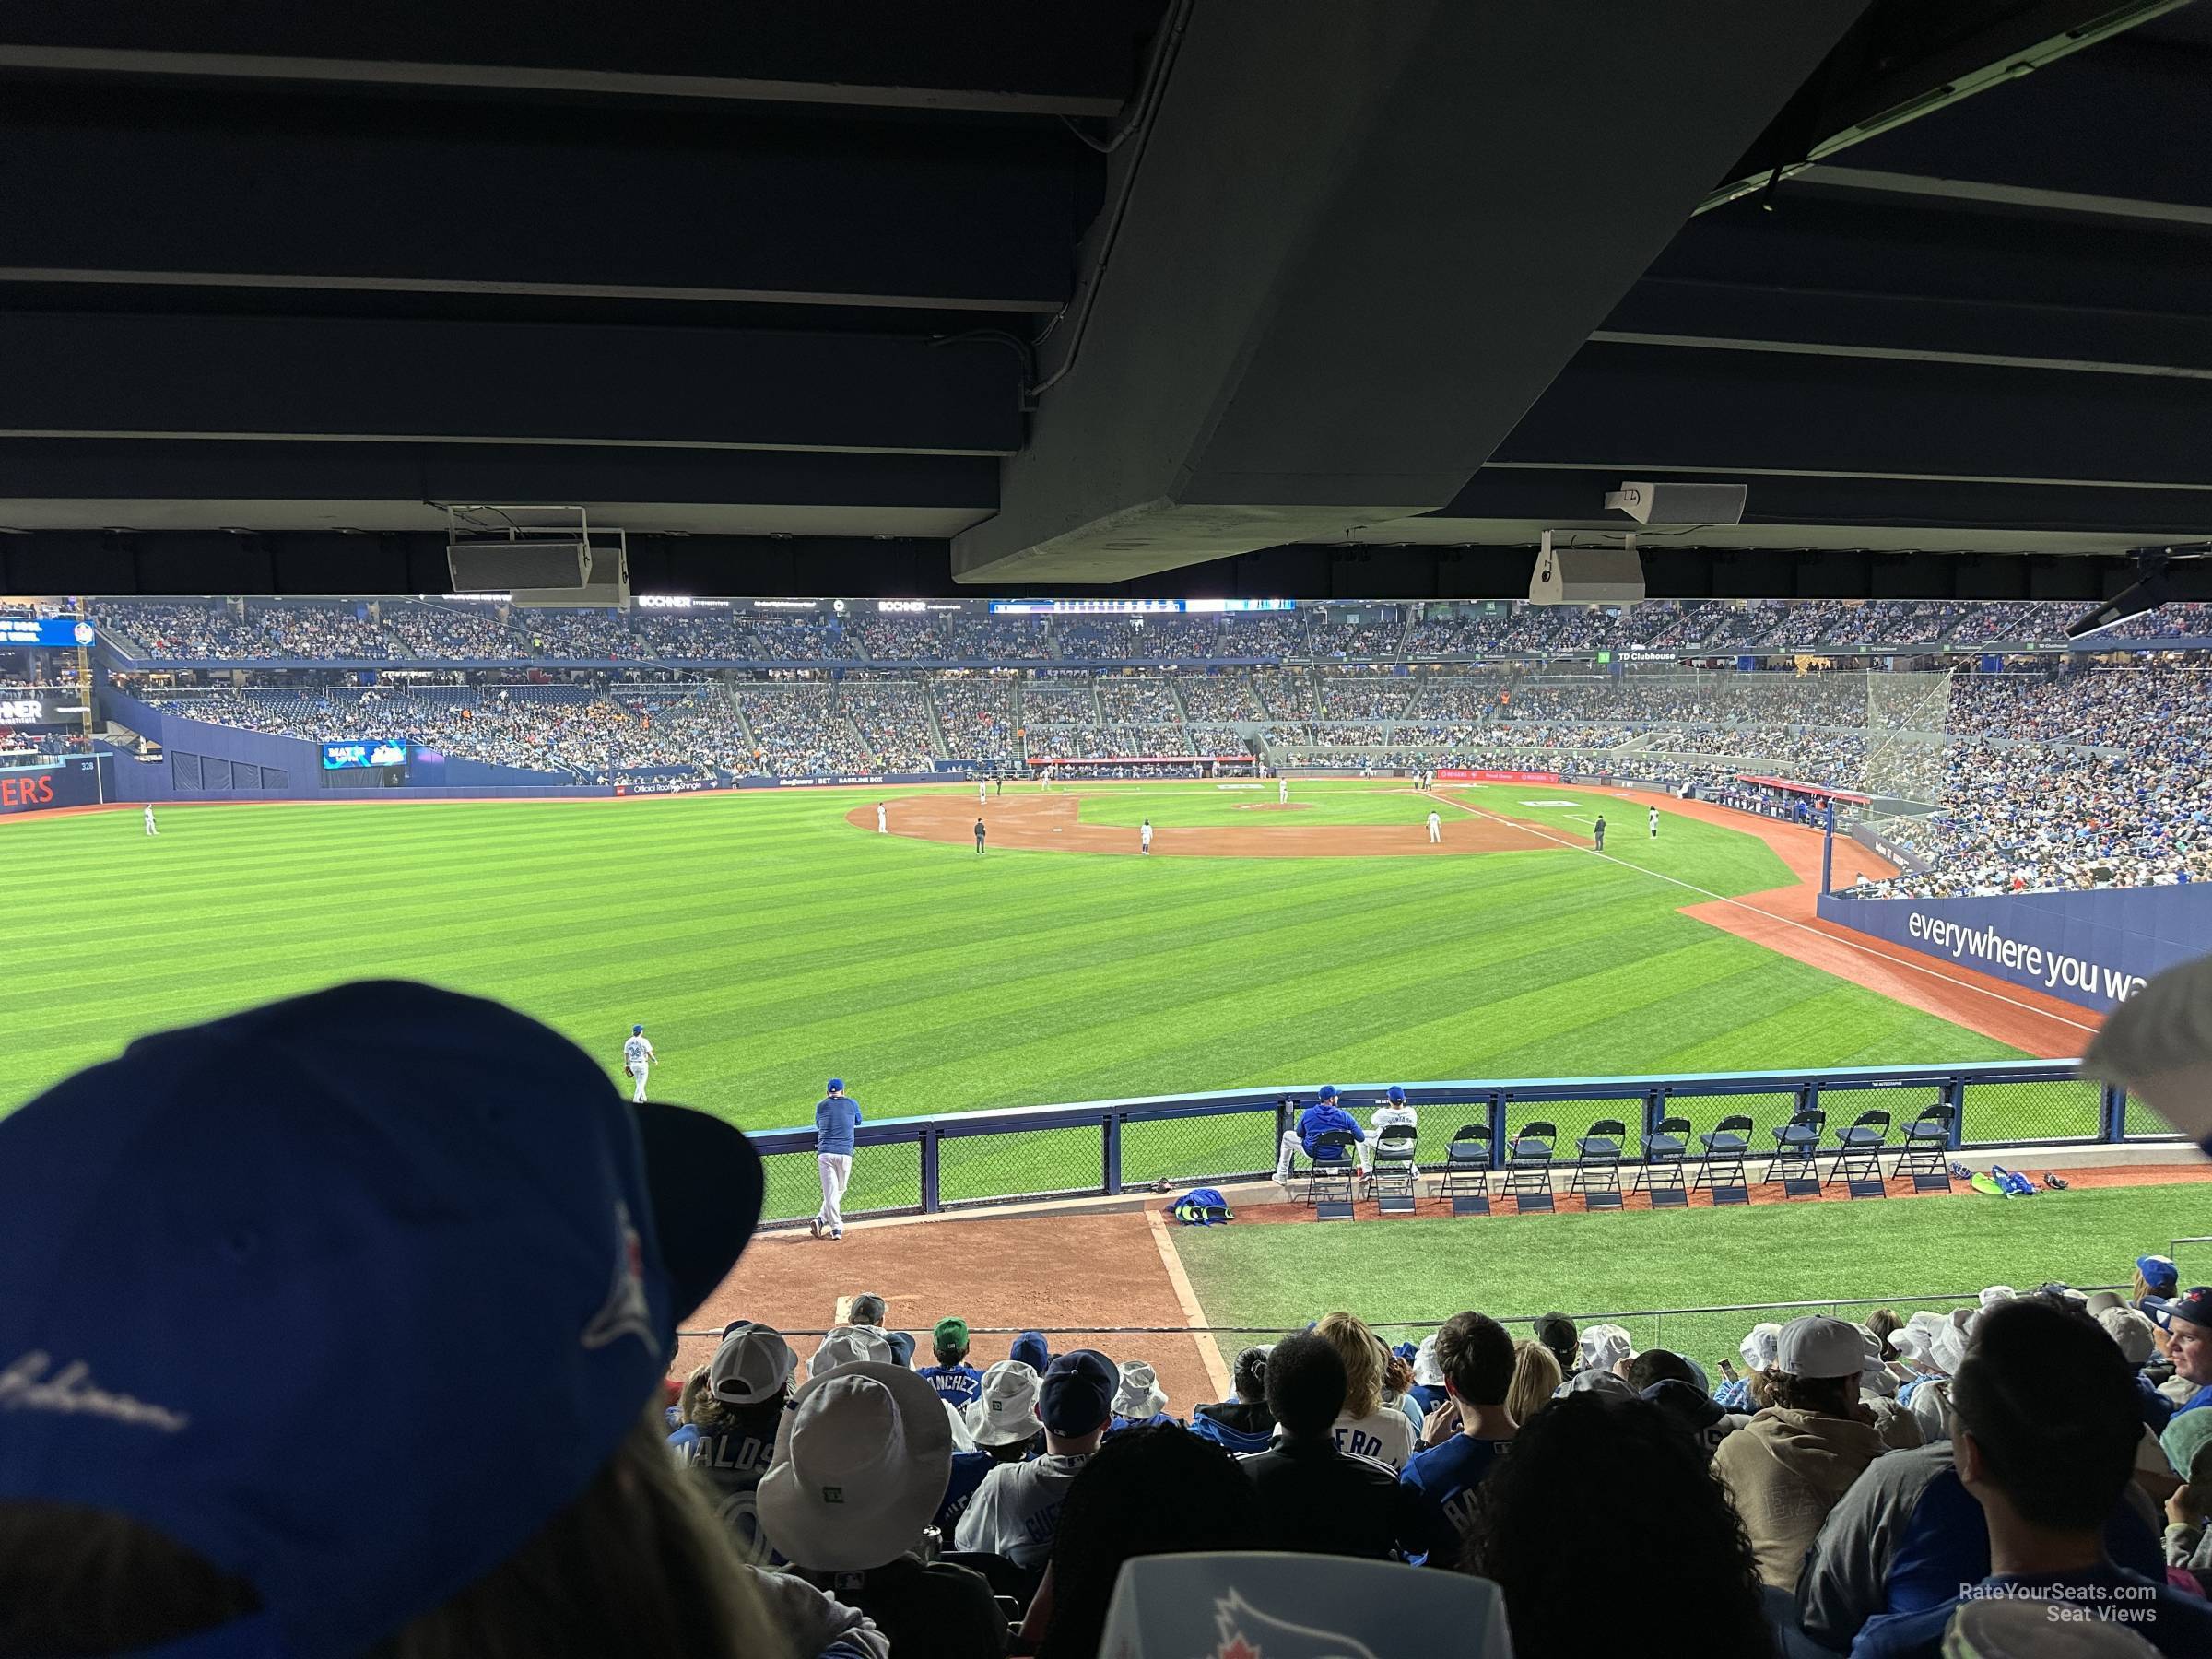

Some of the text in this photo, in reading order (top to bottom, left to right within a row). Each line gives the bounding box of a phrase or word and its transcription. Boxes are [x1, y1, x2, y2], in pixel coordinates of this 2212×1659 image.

[1618, 648, 1676, 661] TD Clubhouse
[81, 761, 94, 771] 328
[1, 775, 53, 806] ERS
[1909, 912, 2042, 975] everywhere
[2045, 951, 2097, 994] you
